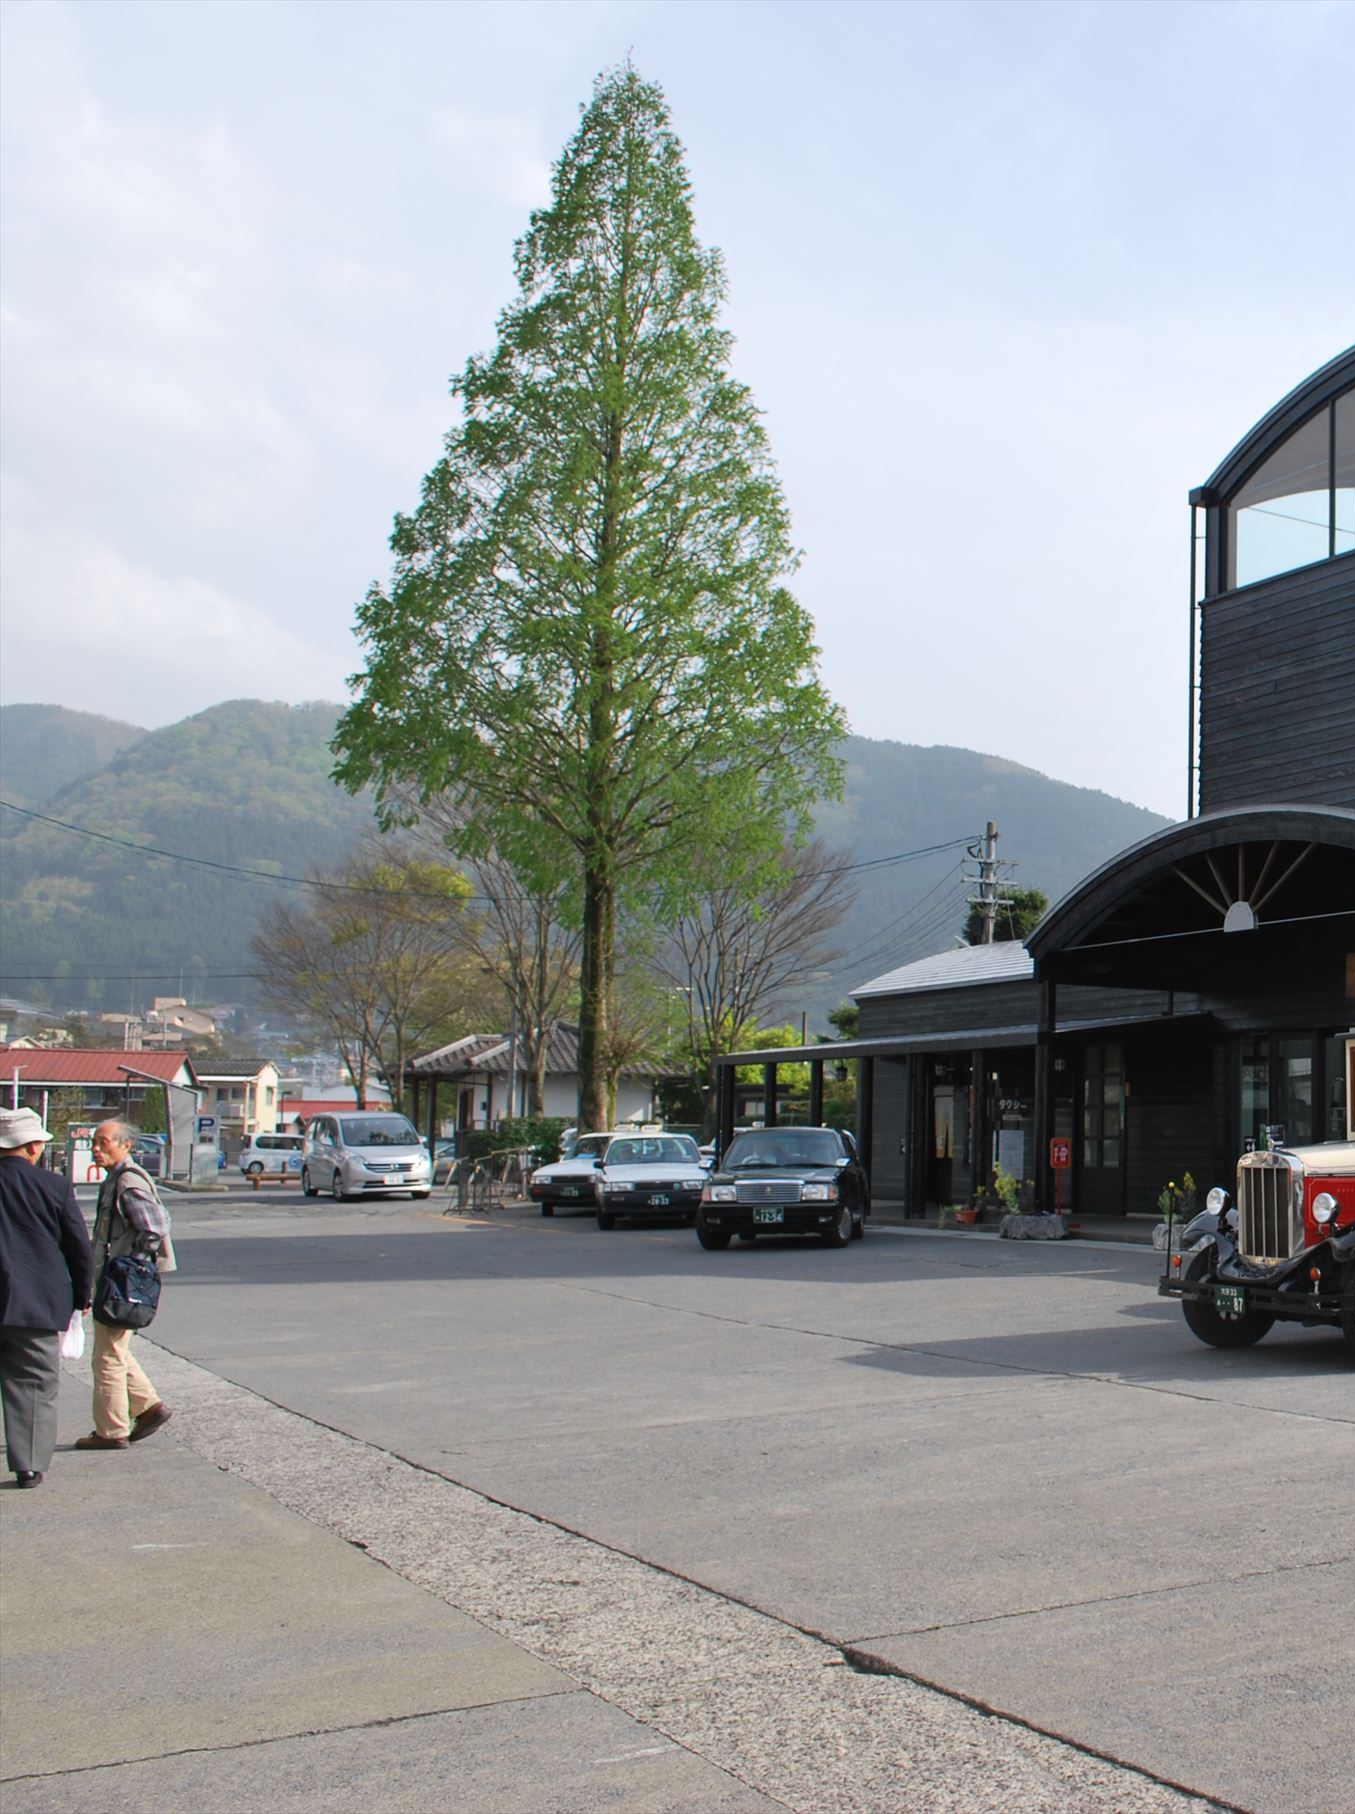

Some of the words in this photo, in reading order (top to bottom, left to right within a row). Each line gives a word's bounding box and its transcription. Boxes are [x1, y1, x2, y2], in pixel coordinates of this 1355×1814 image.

[998, 1099, 1027, 1110] タクシー
[198, 1117, 215, 1132] P
